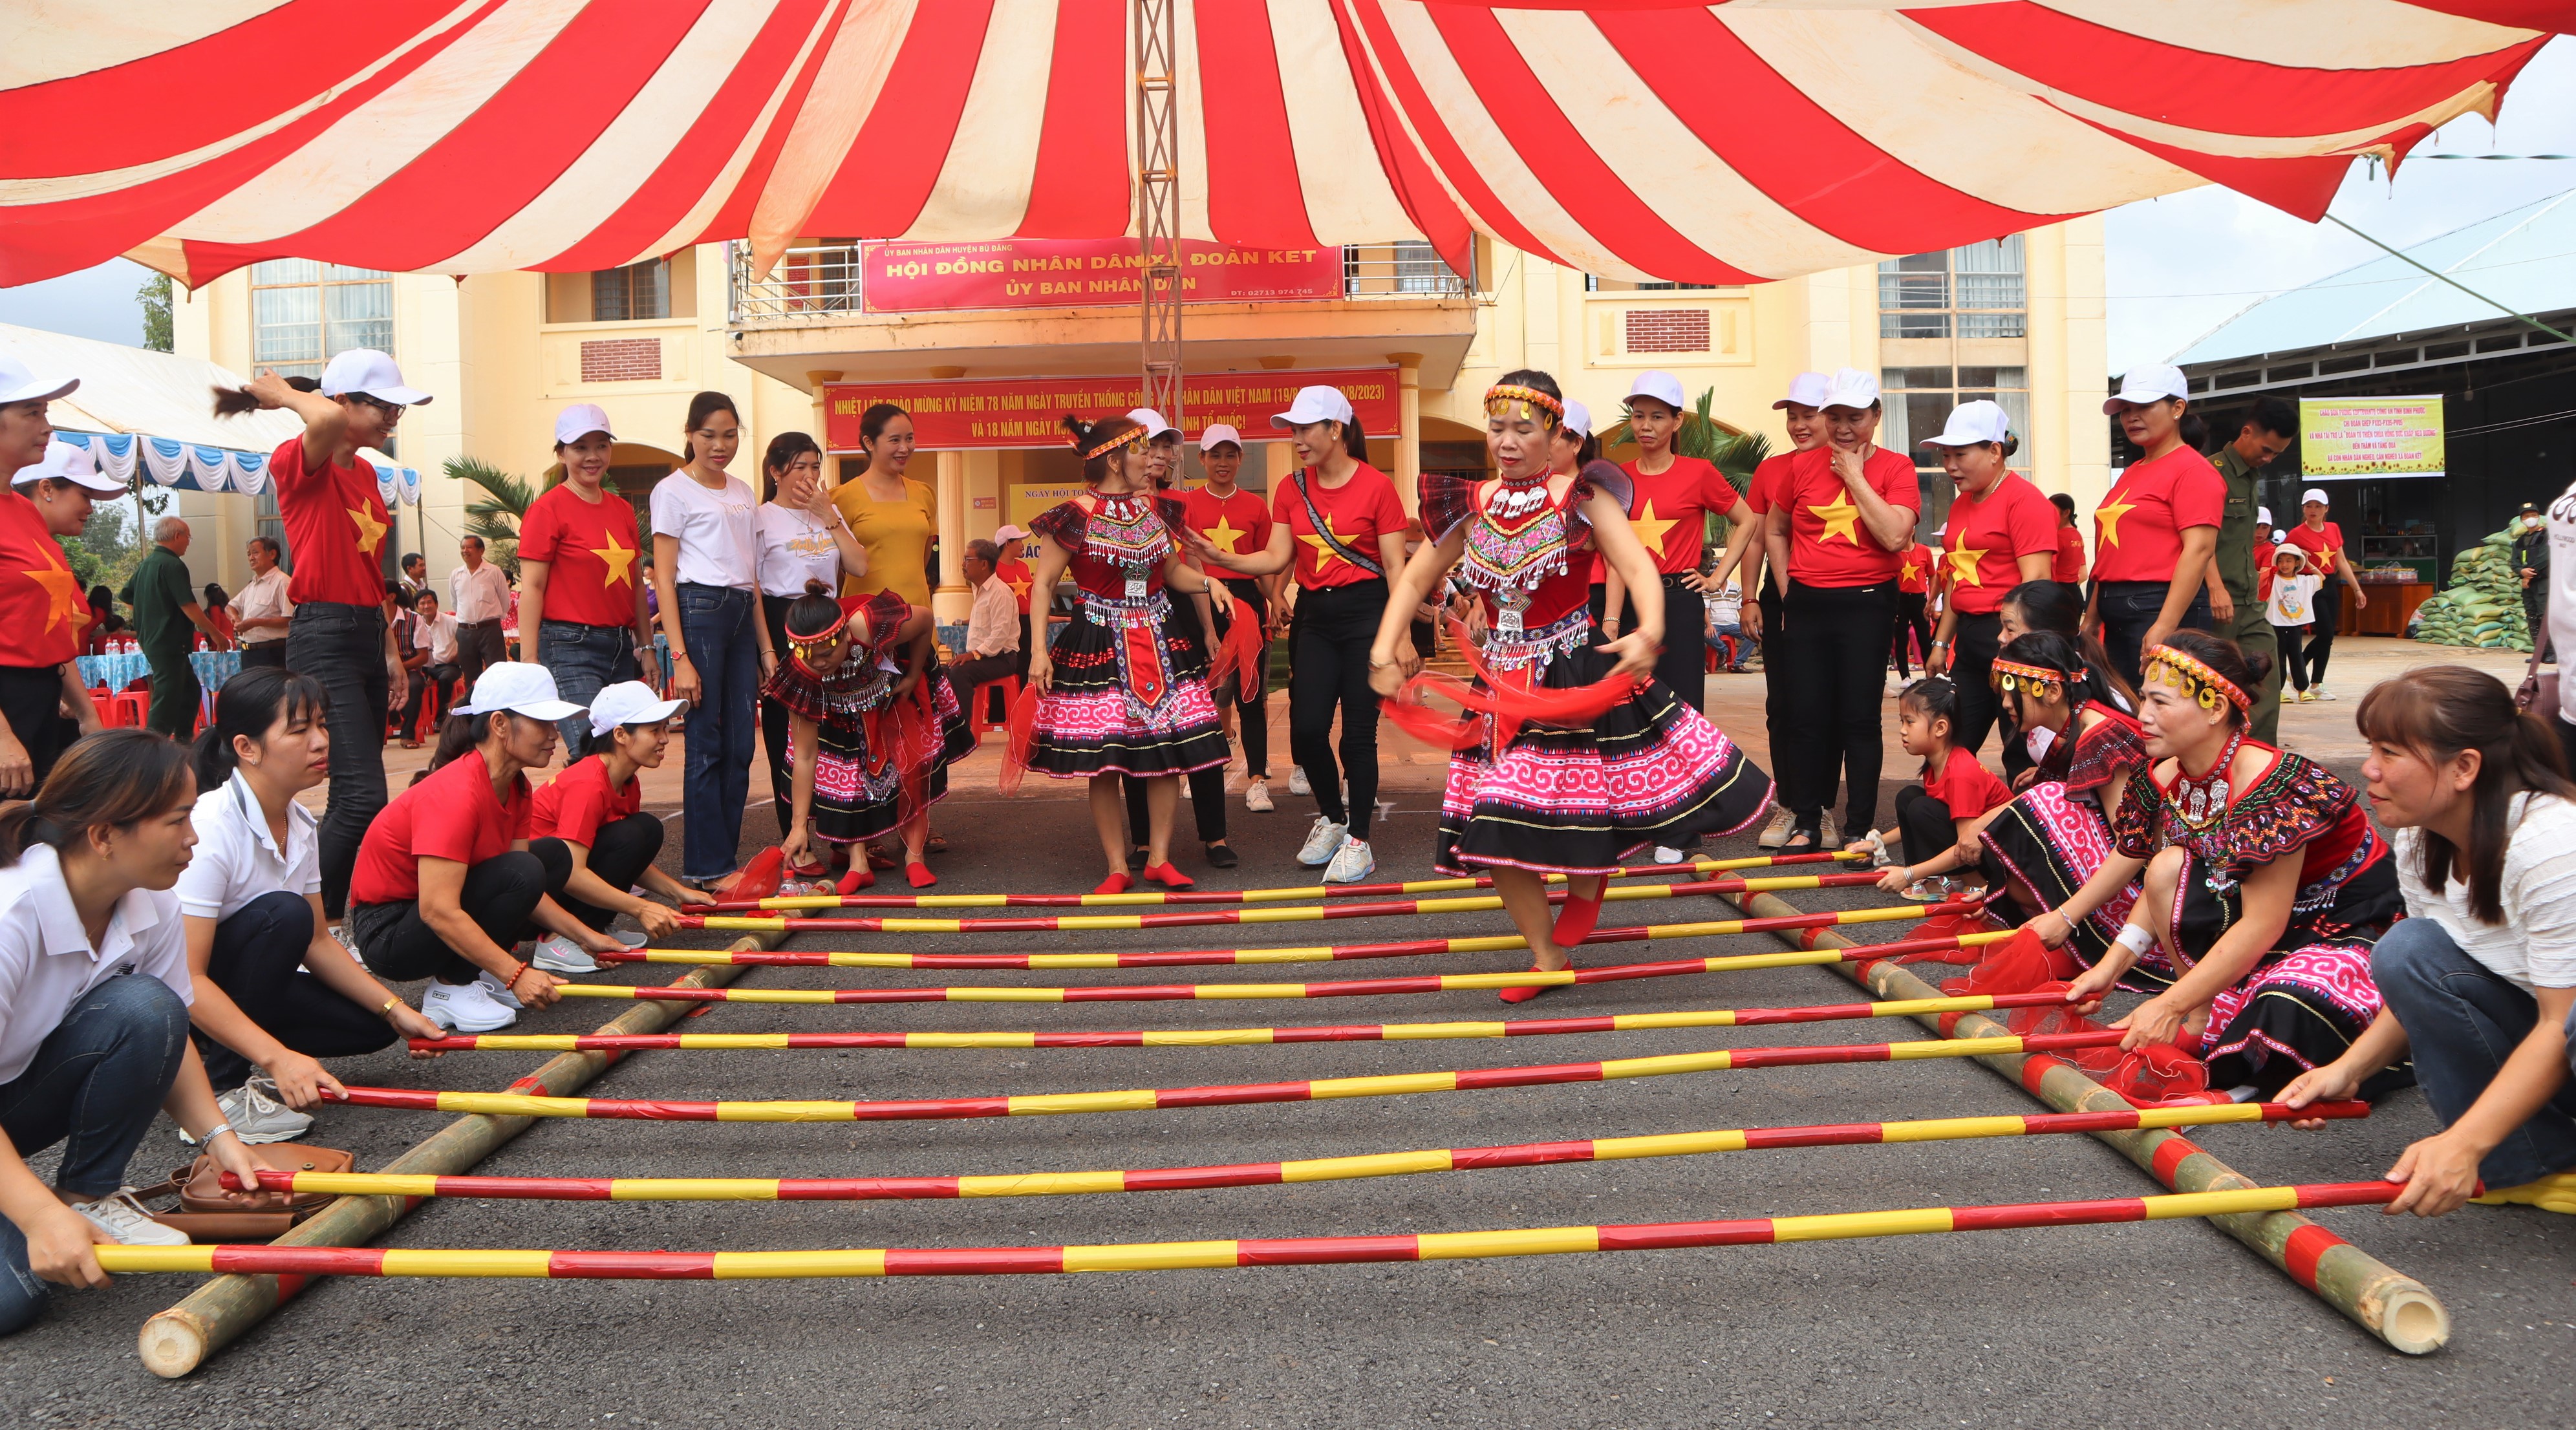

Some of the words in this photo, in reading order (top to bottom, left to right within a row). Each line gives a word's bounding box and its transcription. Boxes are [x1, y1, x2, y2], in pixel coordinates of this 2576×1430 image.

[885, 248, 896, 257] ỦY
[896, 248, 911, 256] BAN
[913, 246, 933, 255] NHÂN
[936, 246, 950, 254] DÂN
[952, 245, 977, 254] HUYỆN
[980, 244, 989, 253] BÙ
[991, 244, 1013, 253] ĐĂNG
[887, 261, 928, 279] HỘI
[936, 256, 1004, 275] ĐỒNG
[1013, 255, 1082, 272] NHÂN
[1091, 253, 1141, 270] DÂN
[1190, 248, 1259, 266] ĐOÀN
[1006, 279, 1033, 296] ỦY
[1040, 281, 1082, 294] BAN
[1088, 277, 1142, 293] NHÂN
[835, 397, 862, 418] NHIỆT
[914, 395, 942, 413] MỪNG
[945, 392, 958, 412] KỶ
[960, 393, 984, 415] NIỆM
[987, 396, 999, 411] 78
[1002, 392, 1024, 411] NĂM
[1026, 391, 1052, 410] NGÀY
[1055, 388, 1091, 409] TRUYỀN
[1093, 387, 1125, 408] THỐNG
[1203, 387, 1223, 405] DÂN
[1225, 385, 1246, 407] VIỆT
[1249, 388, 1271, 404] NAM
[971, 419, 984, 438] VÀ
[987, 422, 998, 437] 18
[1001, 418, 1023, 437] NĂM
[1026, 417, 1052, 436] NGÀY
[1025, 489, 1050, 498] NGÀY
[1053, 488, 1069, 498] HỘI
